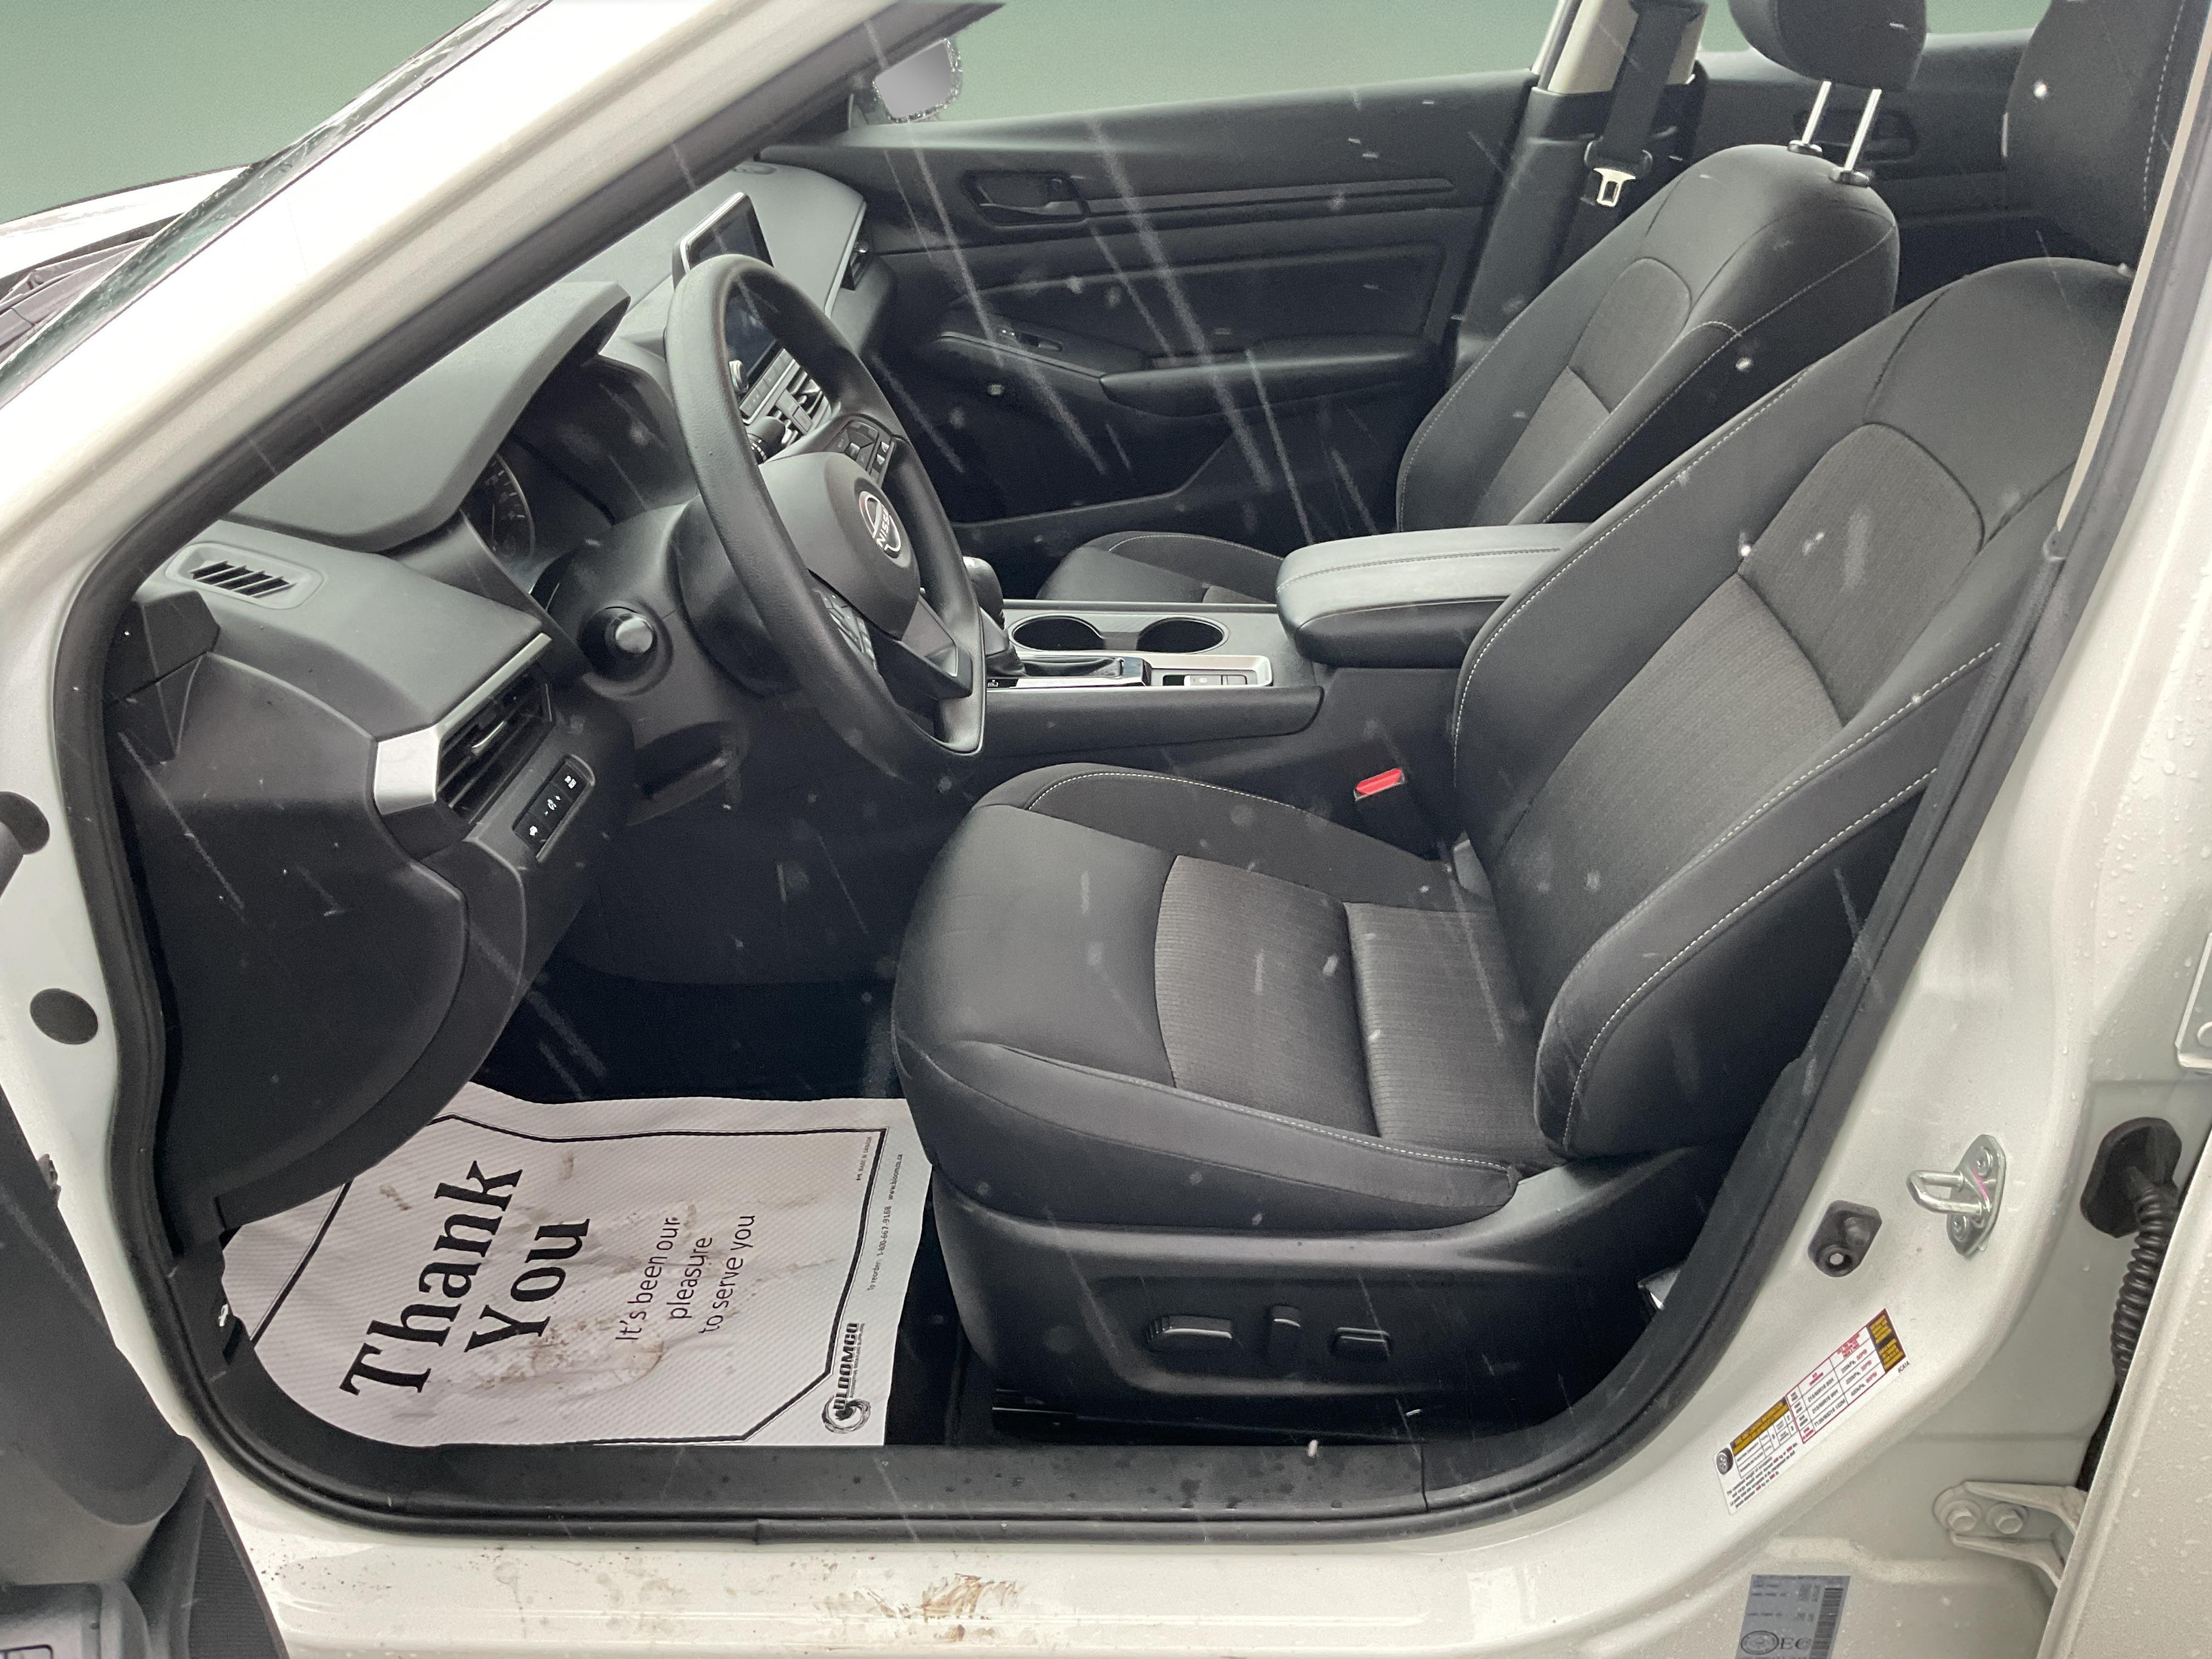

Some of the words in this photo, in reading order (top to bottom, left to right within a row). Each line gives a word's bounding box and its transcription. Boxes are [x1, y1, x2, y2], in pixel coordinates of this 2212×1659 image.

[876, 506, 891, 548] NISS
[656, 1217, 681, 1251] our
[698, 1315, 724, 1334] to
[712, 1256, 744, 1309] serve
[730, 1215, 756, 1251] you
[339, 1160, 523, 1396] Thank
[464, 1218, 590, 1353] You
[627, 1256, 668, 1304] been
[666, 1237, 713, 1319] pleasure
[615, 1310, 647, 1340] It's
[833, 1322, 859, 1410] BLOOMCO
